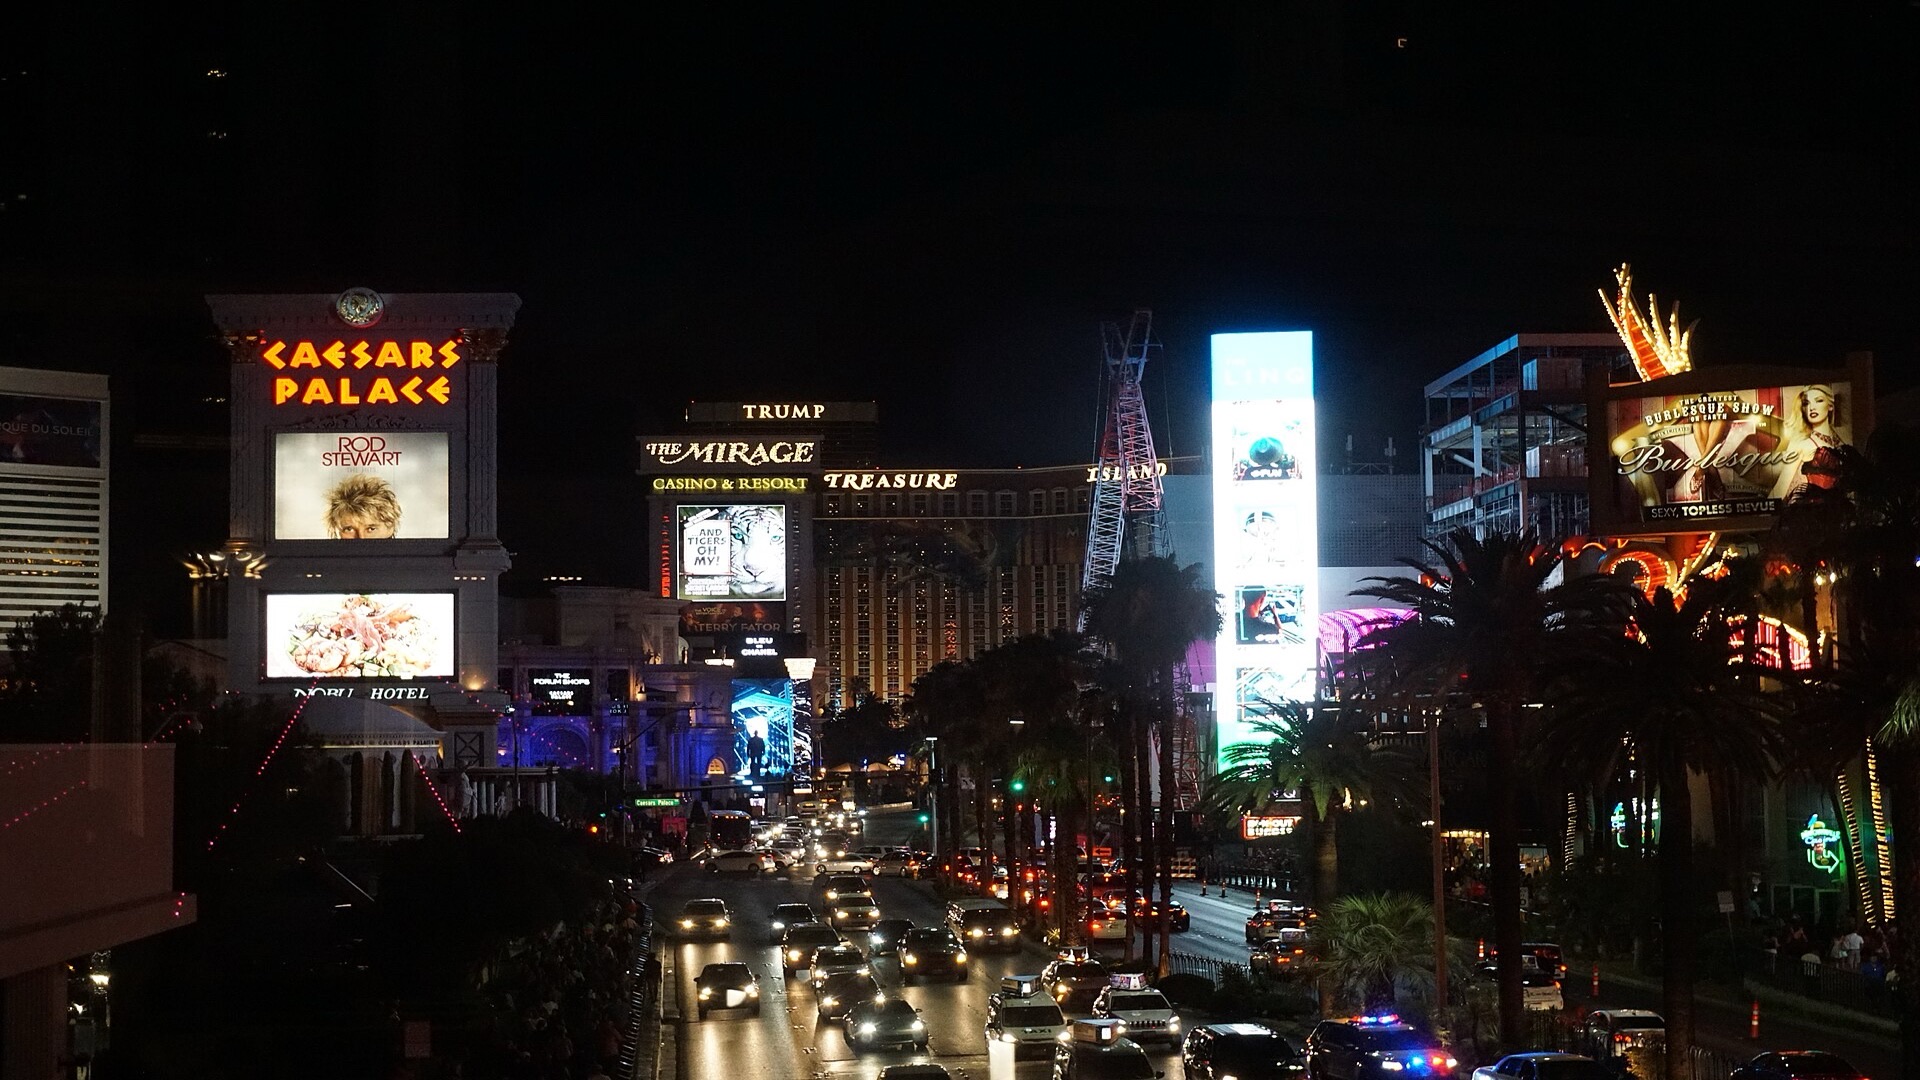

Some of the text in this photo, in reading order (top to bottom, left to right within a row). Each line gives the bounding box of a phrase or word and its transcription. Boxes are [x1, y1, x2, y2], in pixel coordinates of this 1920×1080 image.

[263, 340, 461, 370] CAESARS
[275, 375, 450, 405] PALACE
[1680, 398, 1695, 407] THE
[742, 404, 825, 419] TRUMP
[1644, 401, 1775, 427] BURLESQUE SHOW
[1690, 415, 1701, 423] ON
[31, 424, 50, 434] DU
[52, 425, 95, 437] SOLEIL
[338, 436, 386, 453] ROD
[322, 451, 403, 468] STEWART
[646, 441, 815, 466] THE MIRAGE
[1617, 443, 1800, 478] Burlesque
[823, 462, 1167, 490] TREASURE ISLAND
[653, 478, 809, 491] CASINO & RESORT
[1651, 501, 1776, 519] SEXY, TOPLESS REVUE
[697, 546, 717, 556] OH
[694, 556, 720, 566] MY!
[699, 623, 781, 633] TERRY FATOR
[370, 687, 430, 700] HOTEL
